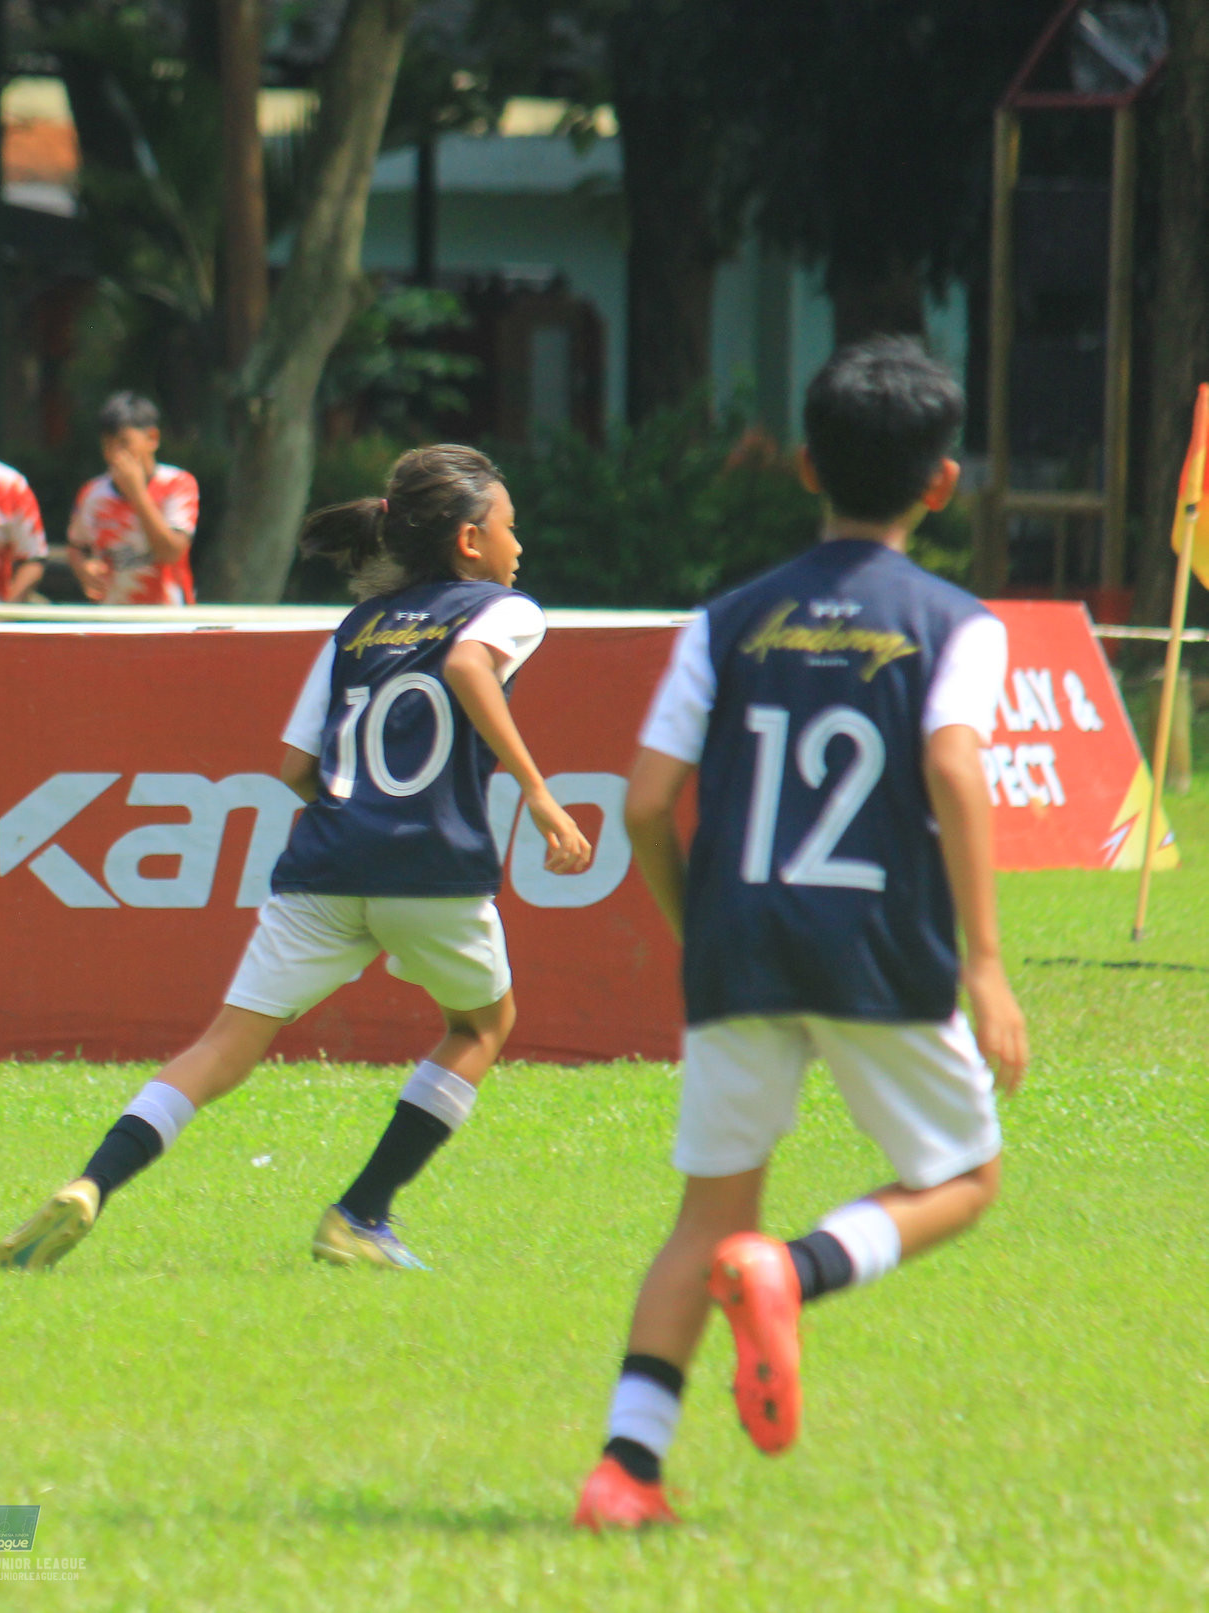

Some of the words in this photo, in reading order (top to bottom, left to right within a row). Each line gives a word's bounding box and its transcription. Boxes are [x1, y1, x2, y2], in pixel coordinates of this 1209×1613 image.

[328, 672, 454, 799] 10
[991, 668, 1063, 732] LAY
[1062, 669, 1105, 732] &
[740, 704, 888, 892] 12
[979, 742, 1066, 807] PECT
